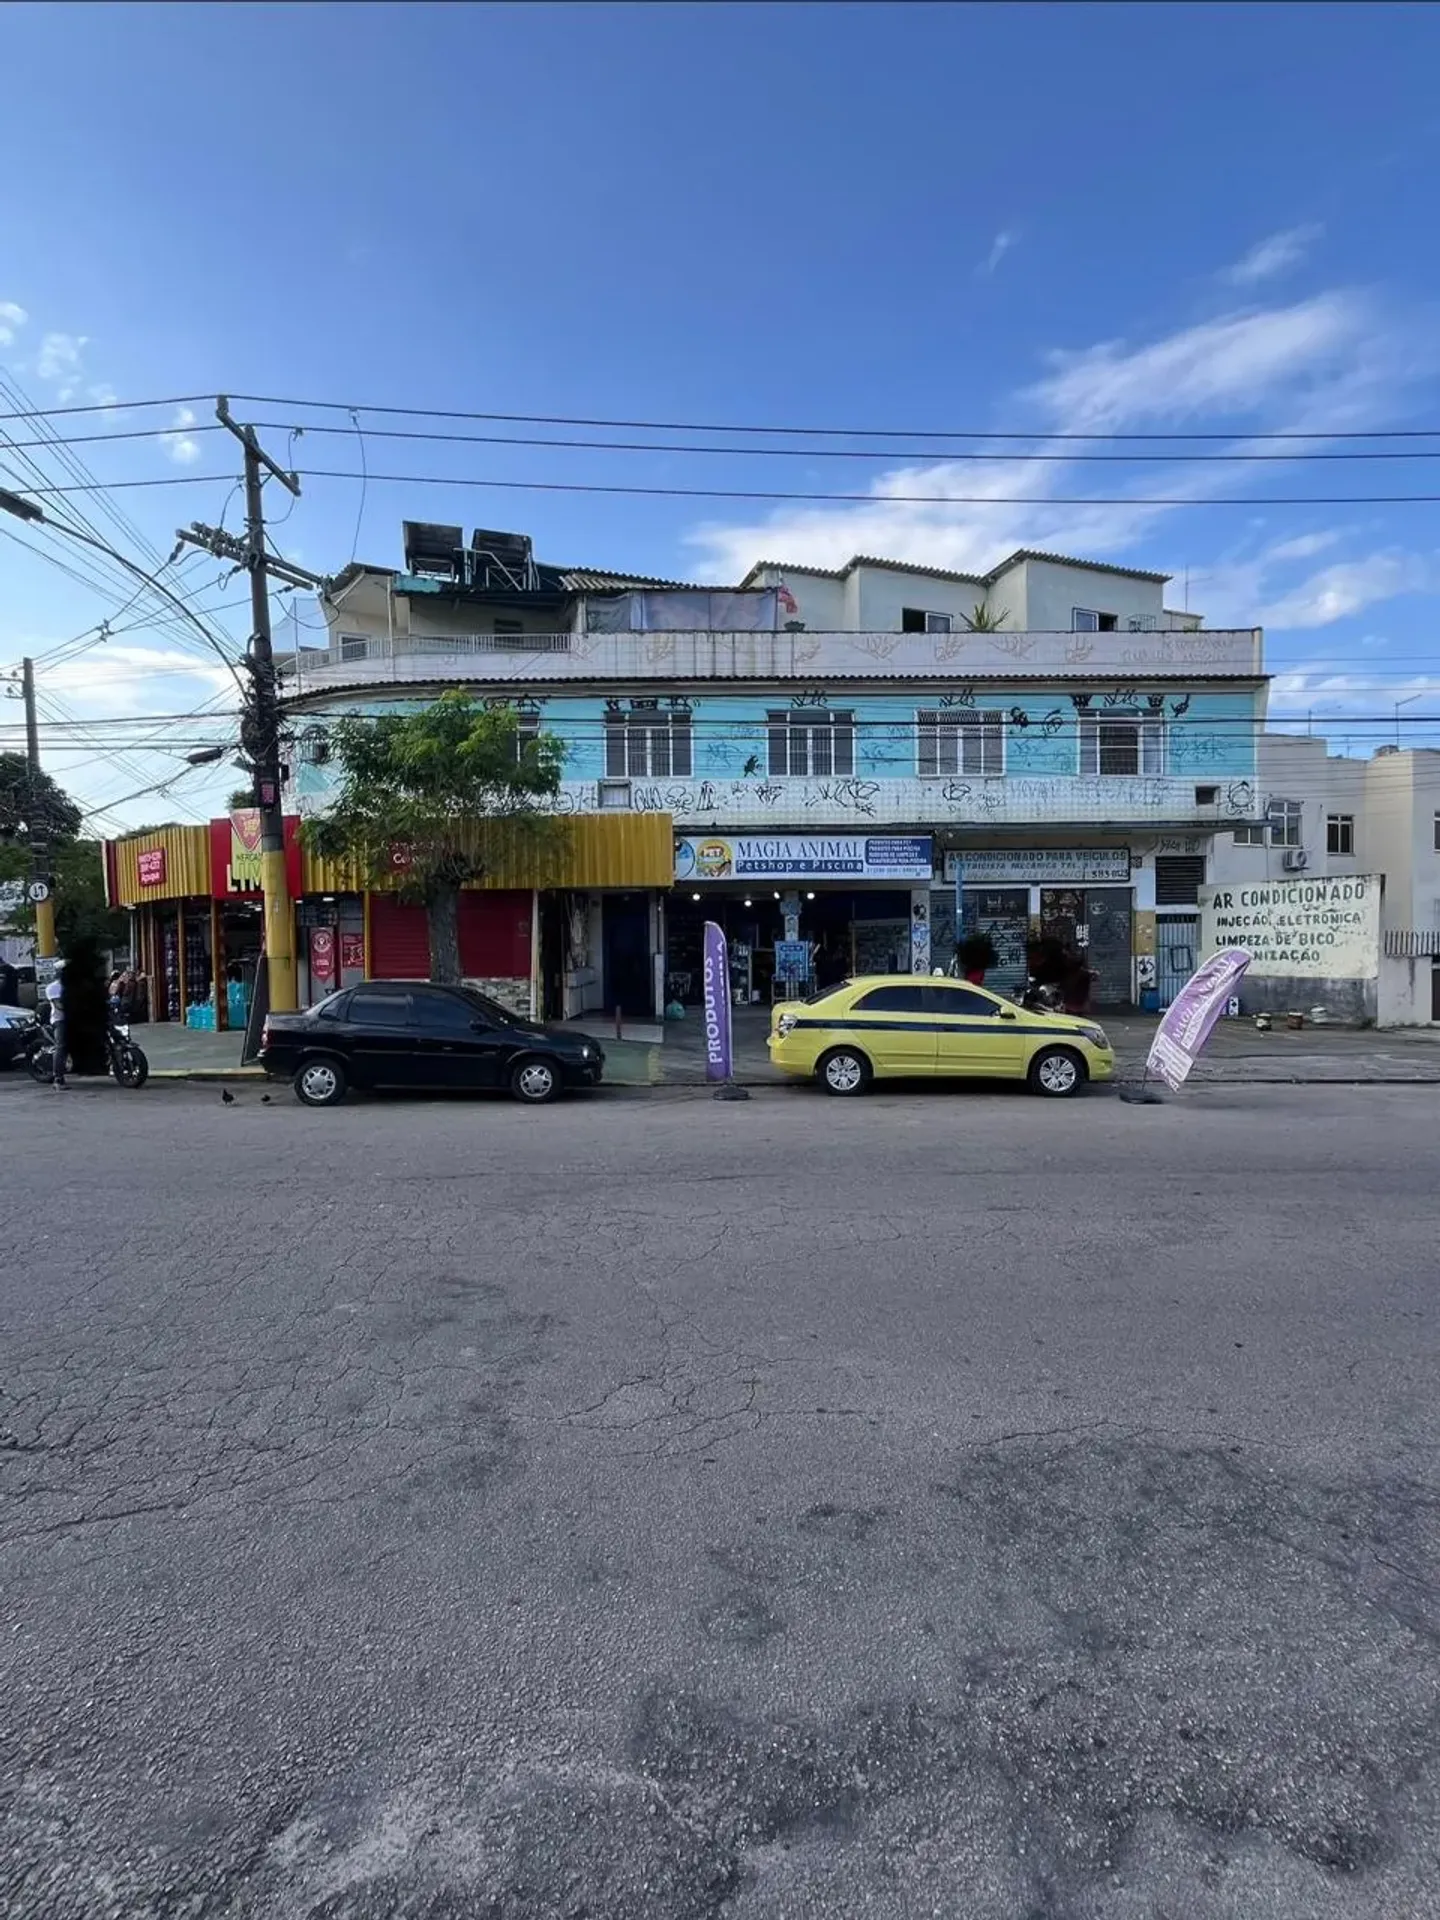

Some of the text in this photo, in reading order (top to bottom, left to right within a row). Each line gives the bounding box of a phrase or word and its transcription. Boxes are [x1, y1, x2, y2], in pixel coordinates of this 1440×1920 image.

[738, 841, 862, 858] MAGIA ANIMAL
[965, 852, 1044, 861] CONDICIONADO
[1046, 852, 1073, 861] PARA
[738, 861, 793, 872] Petshop
[799, 862, 806, 870] e
[812, 860, 863, 870] Piscina
[1213, 883, 1365, 910] AR CONDICIONADO
[1216, 932, 1335, 946] LIMPEZA DE BICO
[705, 957, 724, 1065] PRODUTOS
